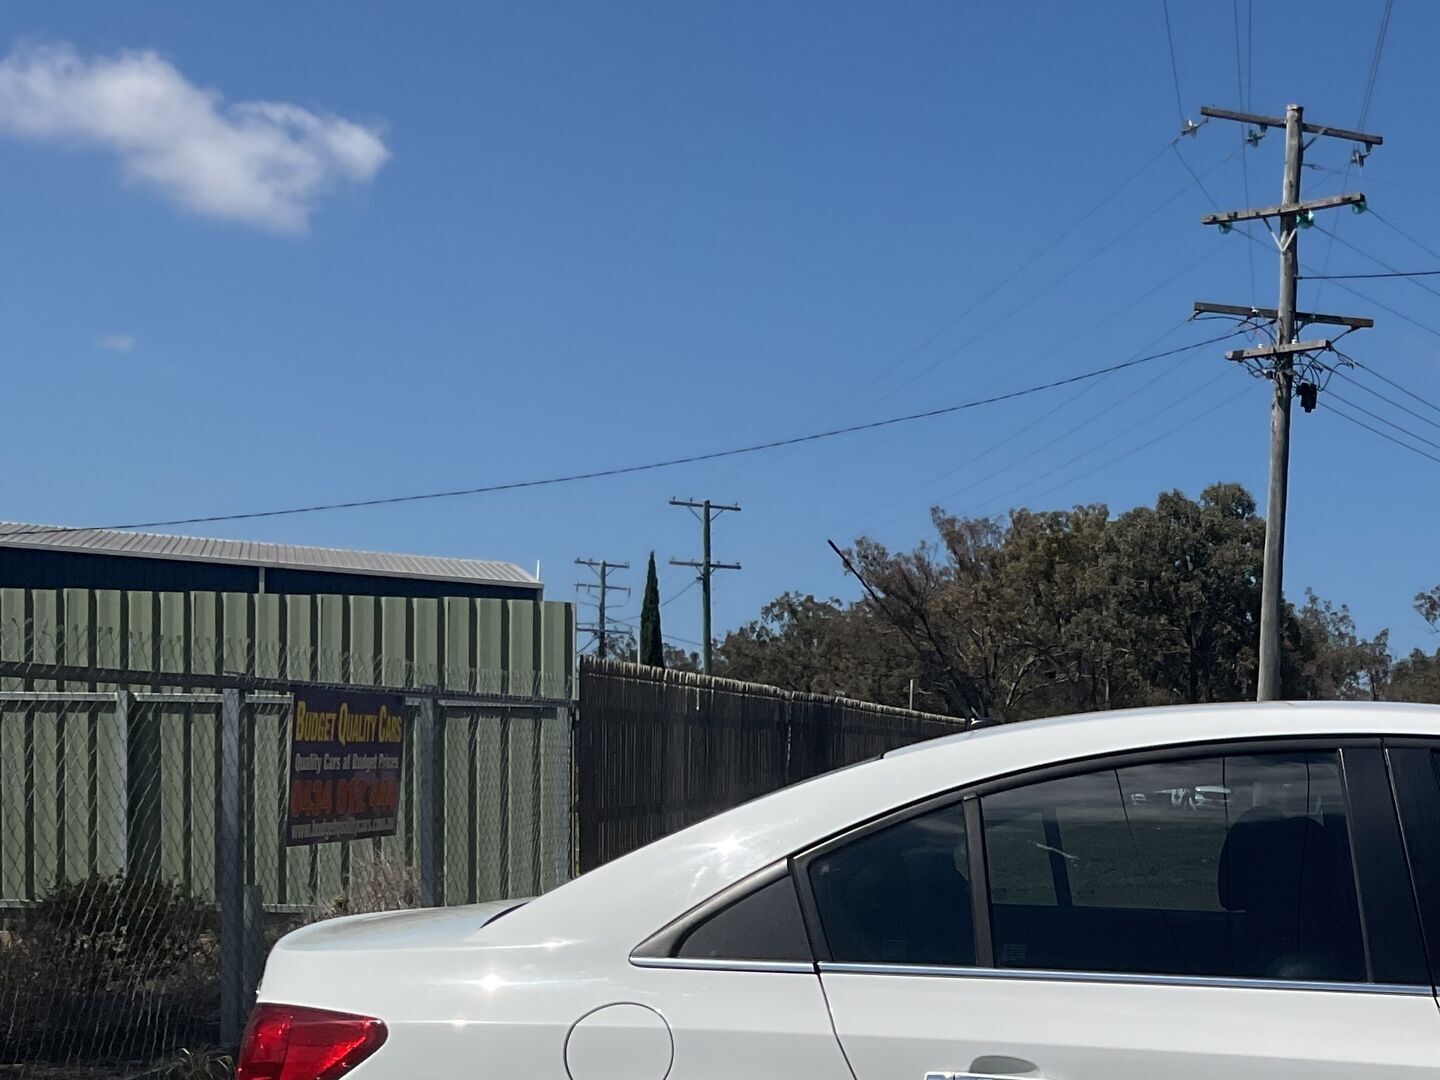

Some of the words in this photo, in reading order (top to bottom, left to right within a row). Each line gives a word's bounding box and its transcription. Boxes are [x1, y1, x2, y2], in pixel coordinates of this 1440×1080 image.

[296, 700, 337, 742] BUDGET
[338, 702, 378, 747] QUALITY
[378, 704, 403, 743] CARS
[295, 752, 322, 775] Quality
[323, 752, 341, 770] Cars
[342, 753, 351, 770] at
[352, 752, 377, 774] Budget
[378, 752, 399, 770] Prices
